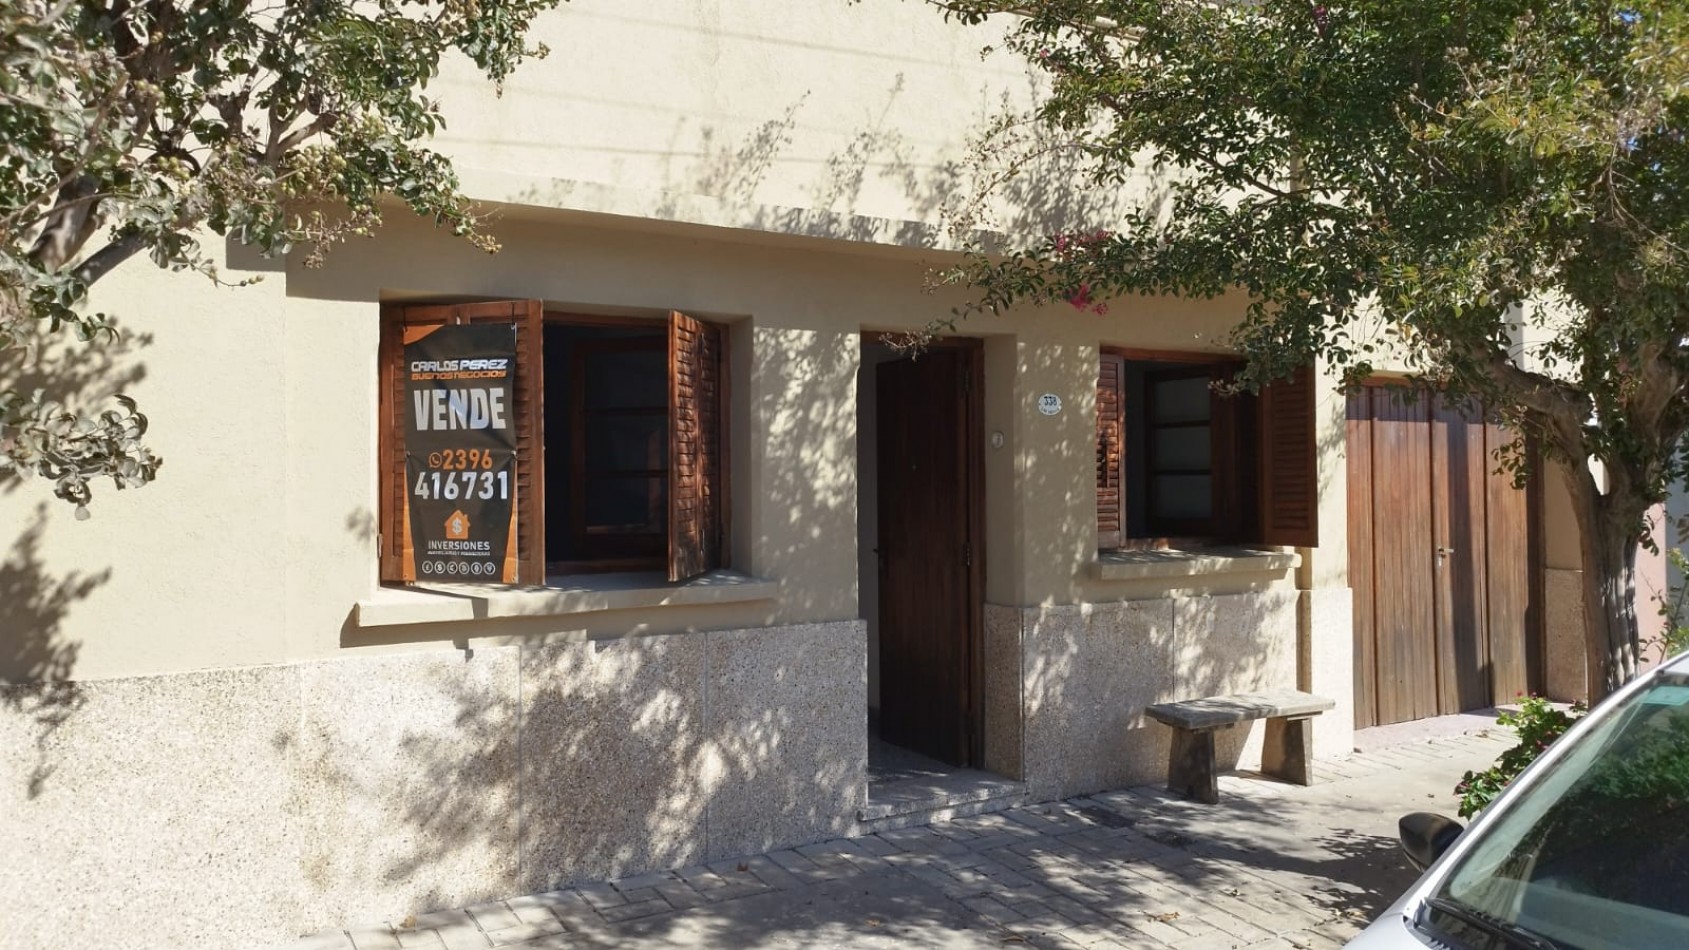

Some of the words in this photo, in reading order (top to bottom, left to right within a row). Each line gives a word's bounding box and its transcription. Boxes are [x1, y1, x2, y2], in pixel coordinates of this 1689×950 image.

[411, 361, 459, 372] CARLOS
[460, 359, 508, 370] PEREZ
[413, 387, 507, 431] VENDE
[442, 449, 493, 470] 2396
[414, 471, 508, 500] 416731
[428, 541, 490, 550] INVERSIONES
